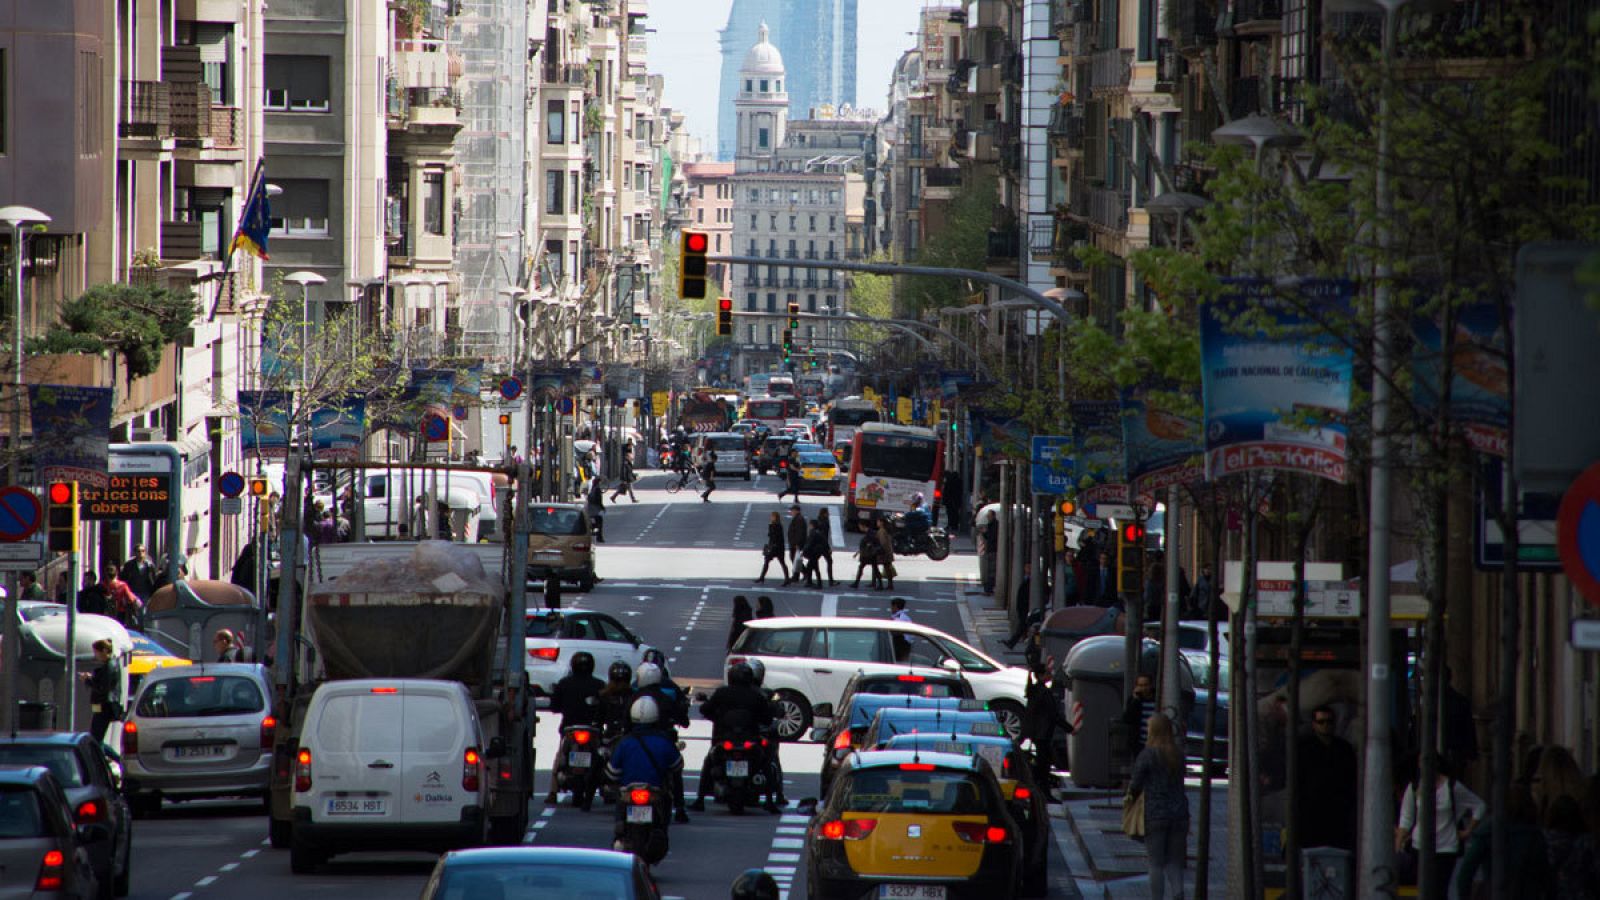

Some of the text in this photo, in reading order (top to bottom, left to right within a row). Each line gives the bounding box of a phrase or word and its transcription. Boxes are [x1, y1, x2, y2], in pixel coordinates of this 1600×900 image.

[1240, 366, 1281, 377] NACIONAL
[1283, 366, 1294, 377] DE
[111, 475, 159, 488] òries
[83, 489, 168, 501] triccions
[91, 501, 139, 513] obres
[425, 794, 452, 802] Dalkia
[889, 886, 916, 897] 3237
